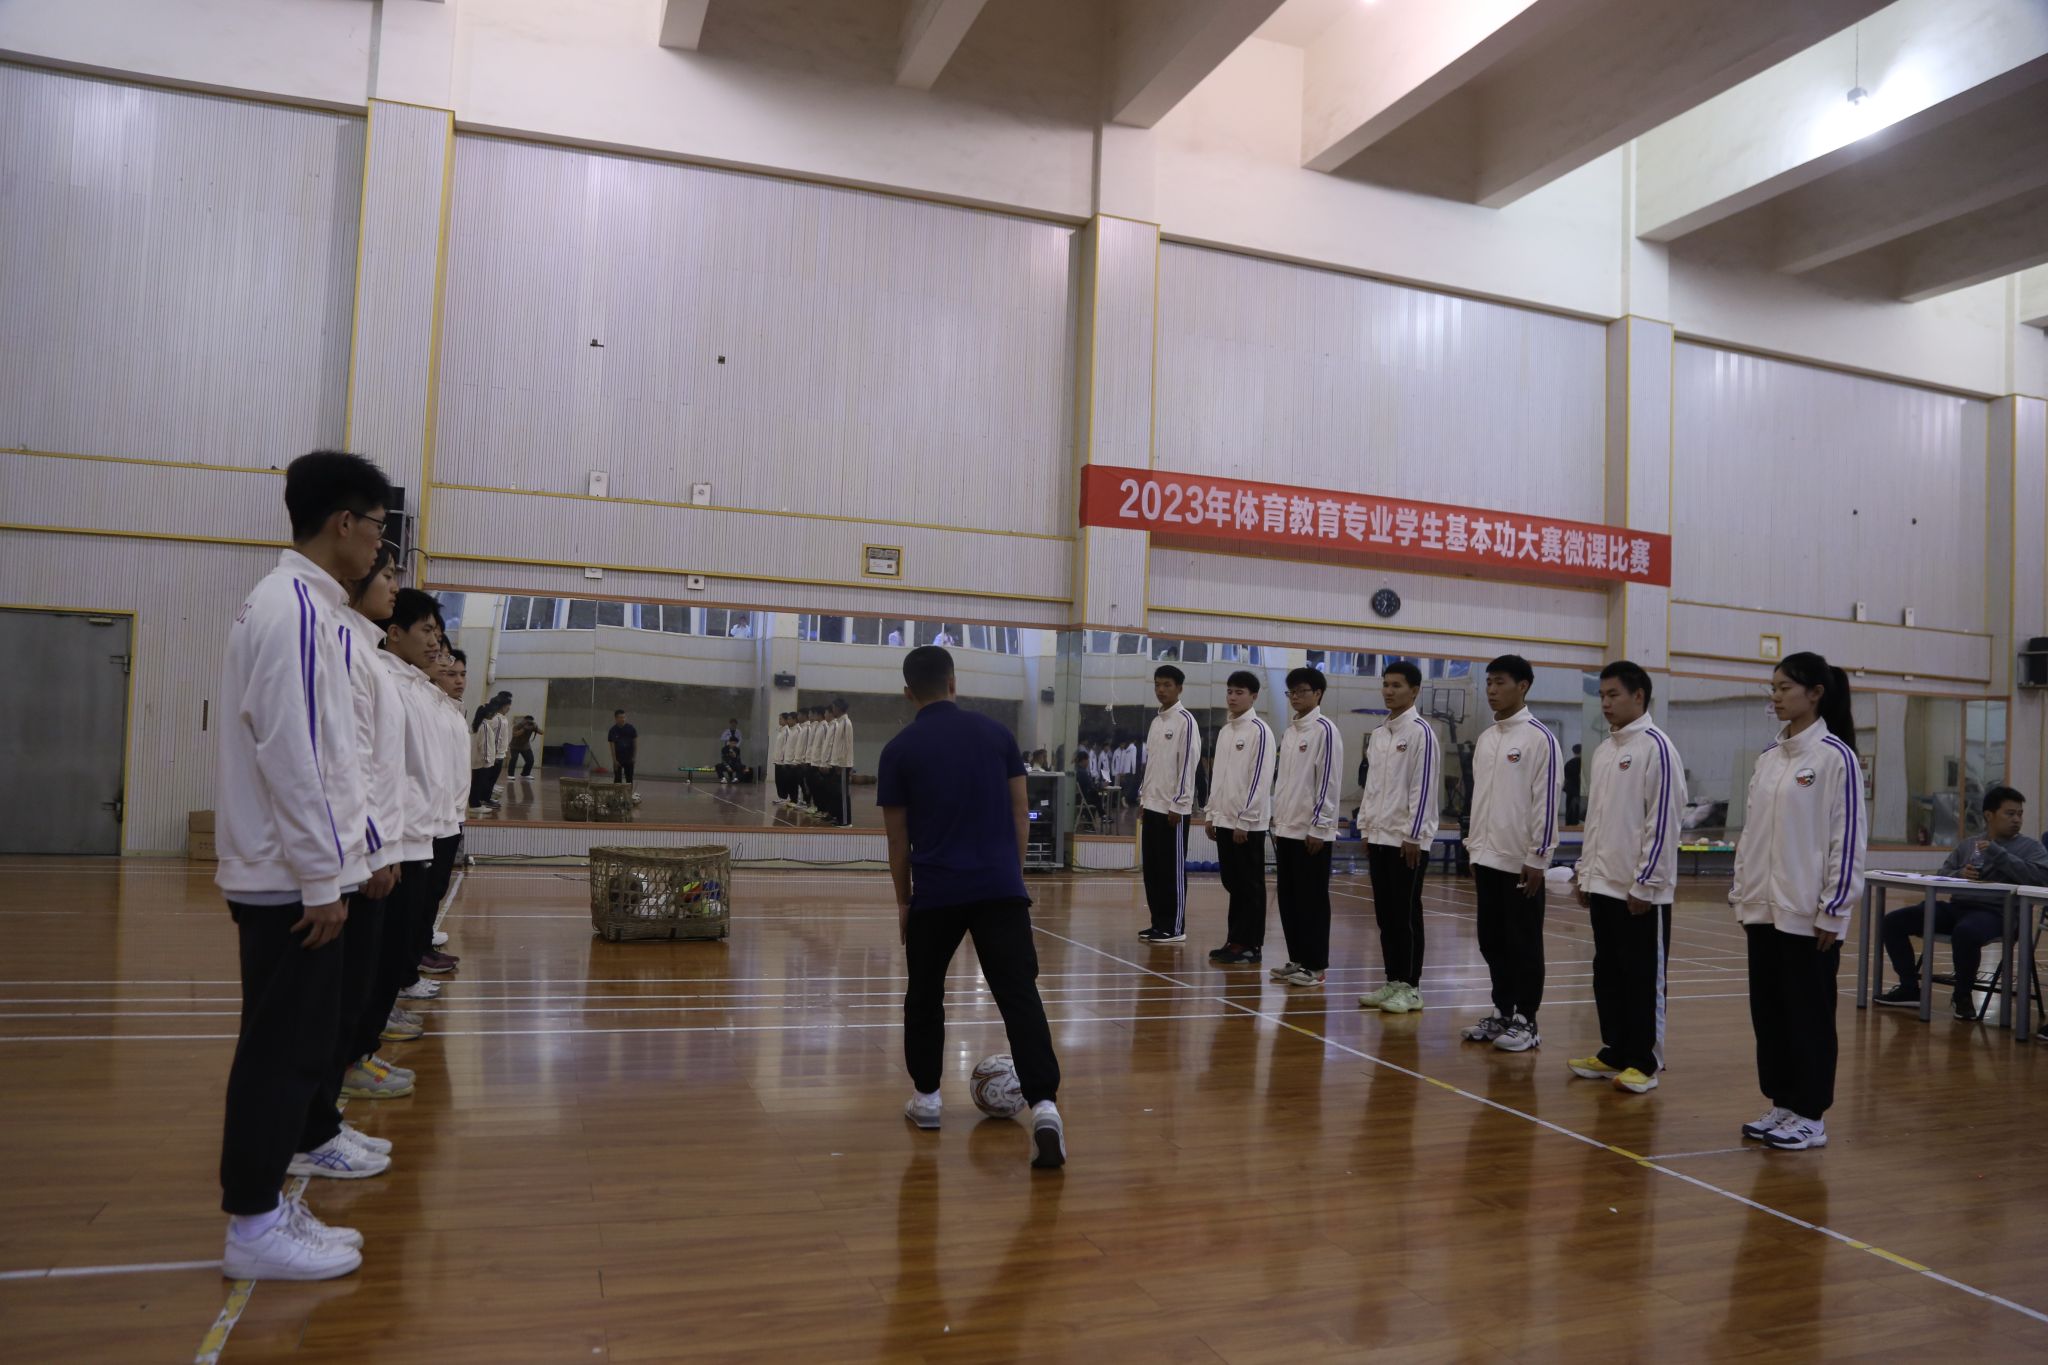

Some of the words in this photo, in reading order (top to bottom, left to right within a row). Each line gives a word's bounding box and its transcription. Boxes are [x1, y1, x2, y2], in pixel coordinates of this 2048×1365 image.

[1119, 478, 1651, 576] 2023年体育教育专业学生基本功大赛微课比赛
